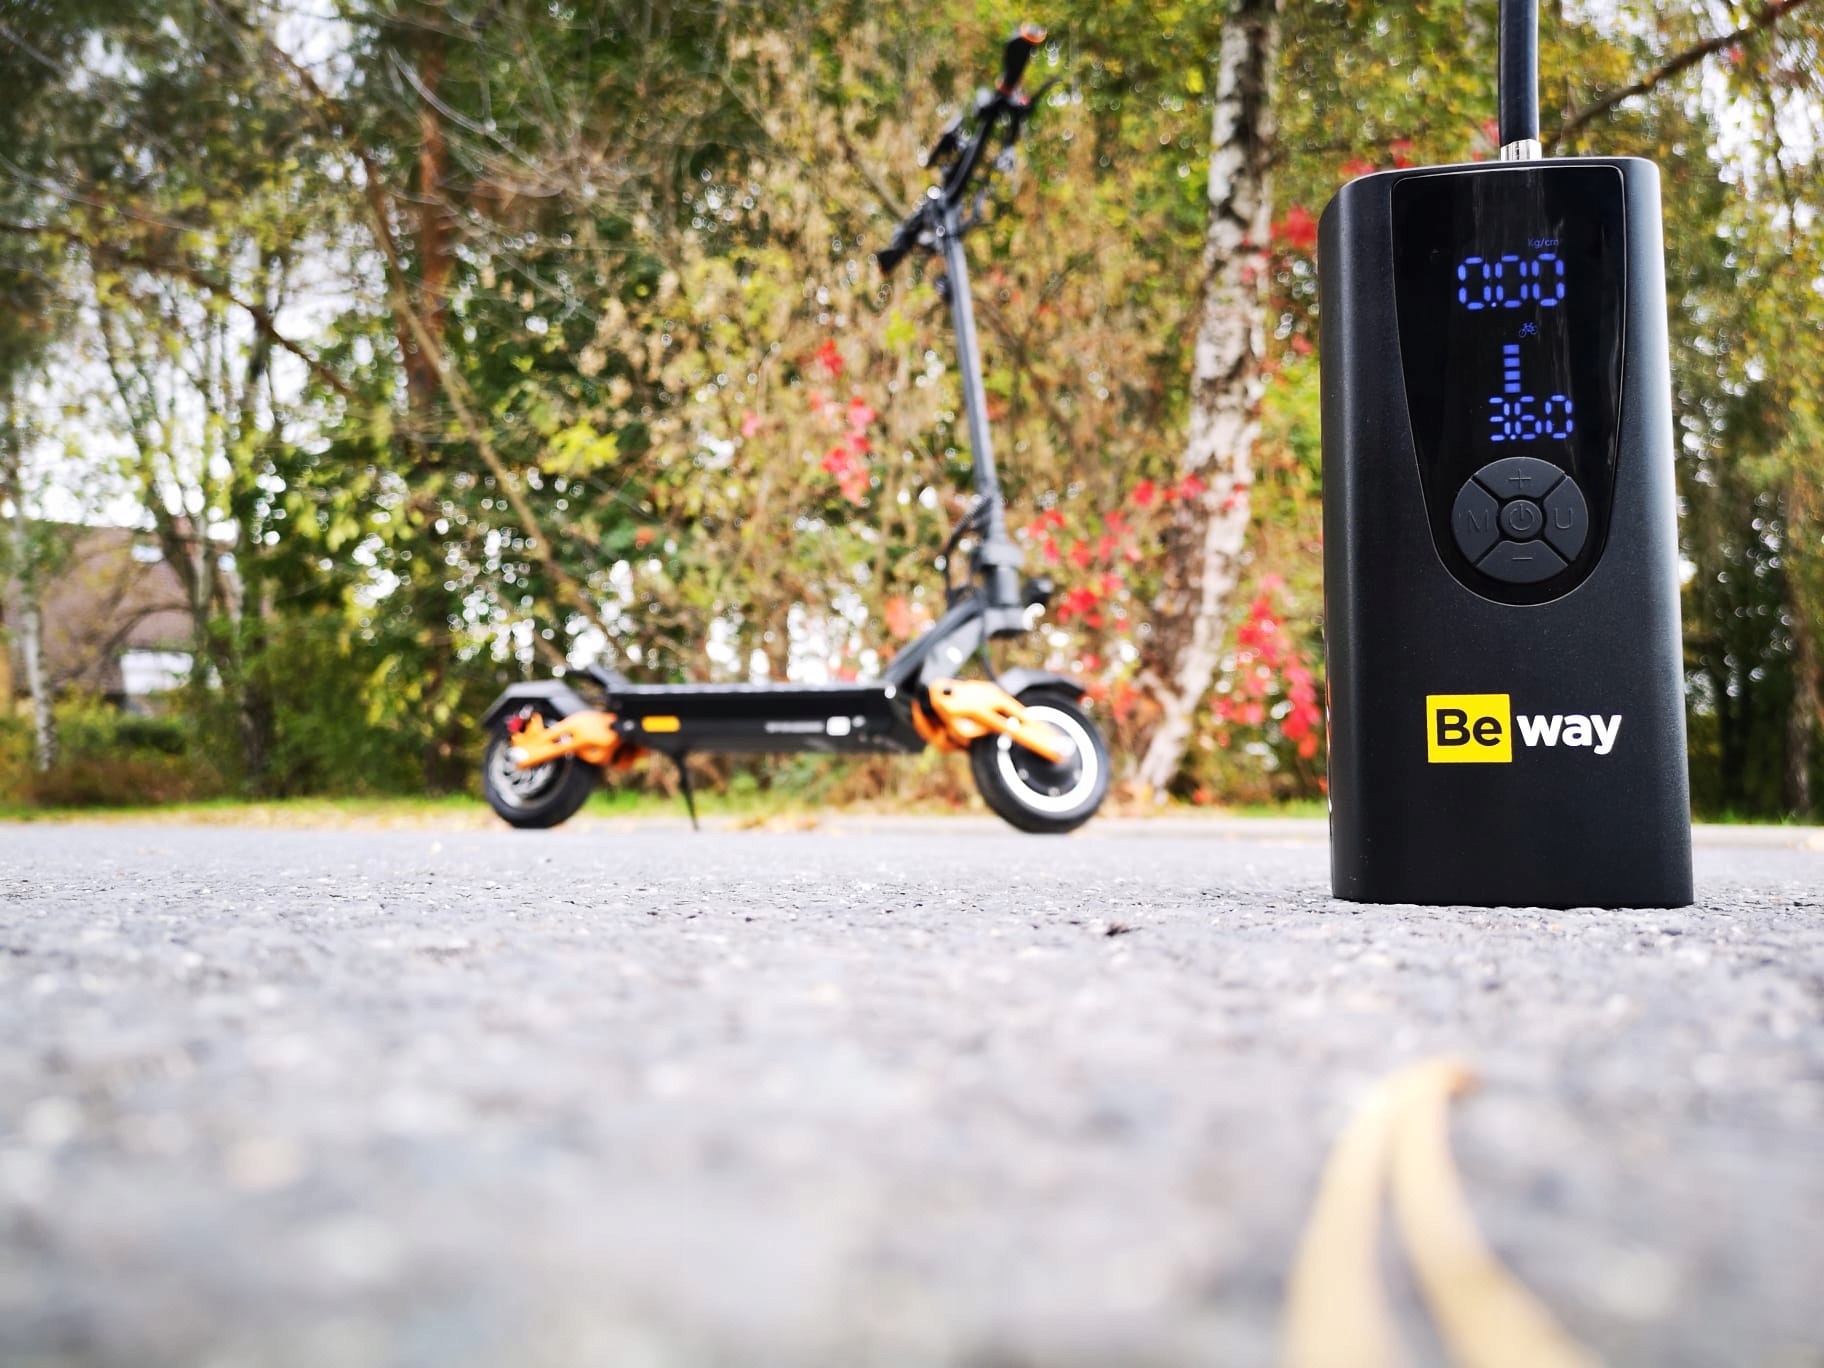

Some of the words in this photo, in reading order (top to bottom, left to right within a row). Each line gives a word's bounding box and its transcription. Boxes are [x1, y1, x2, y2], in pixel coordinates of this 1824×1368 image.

[1554, 506, 1575, 529] U
[1436, 708, 1503, 747] Be
[1516, 714, 1622, 755] way
